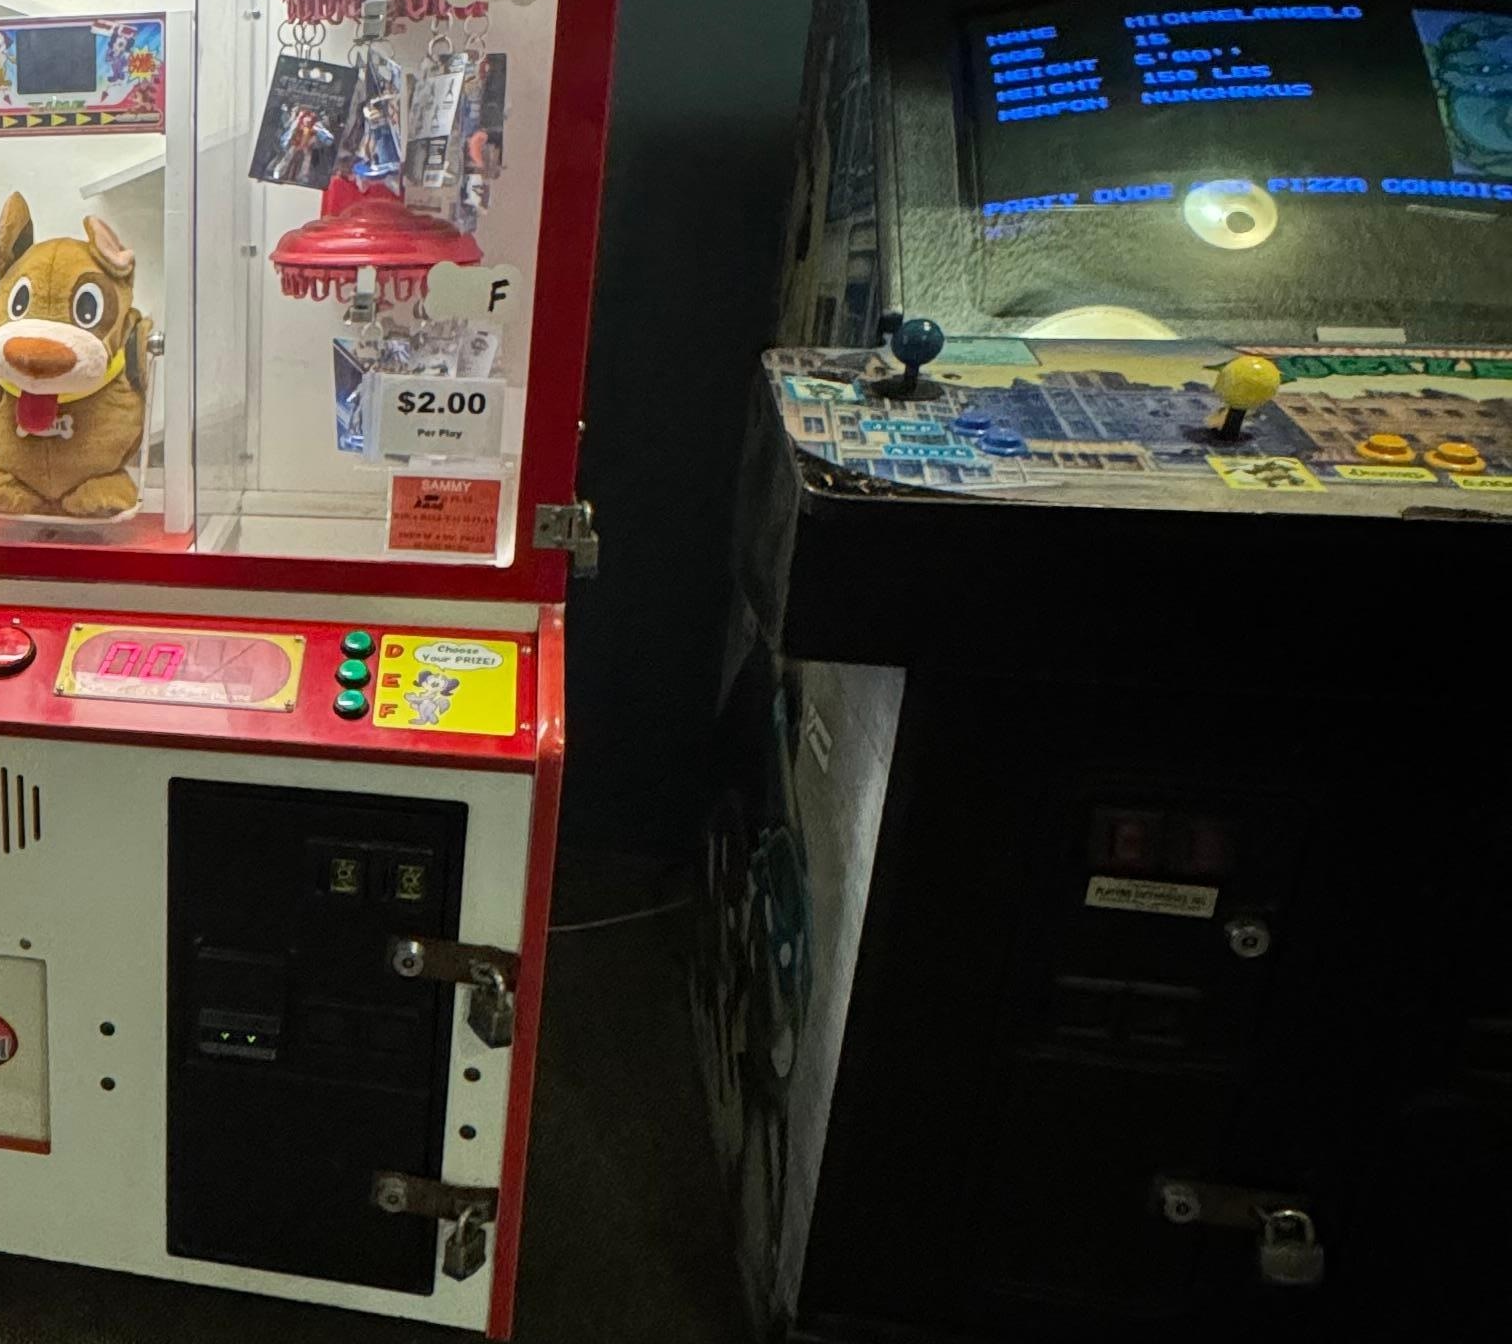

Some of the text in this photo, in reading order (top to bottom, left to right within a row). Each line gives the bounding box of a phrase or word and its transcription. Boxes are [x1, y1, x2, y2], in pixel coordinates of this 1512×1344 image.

[1212, 64, 1272, 80] LBS
[983, 193, 1079, 217] PARTY
[1091, 182, 1174, 204] DUDE
[1268, 177, 1368, 194] PIZZA
[489, 279, 510, 312] F
[397, 390, 487, 416] $2.00
[417, 428, 463, 439] Per Play
[384, 643, 480, 659] D Choose
[422, 653, 496, 666] Your PRIZE!
[381, 673, 403, 689] E
[378, 703, 399, 719] F
